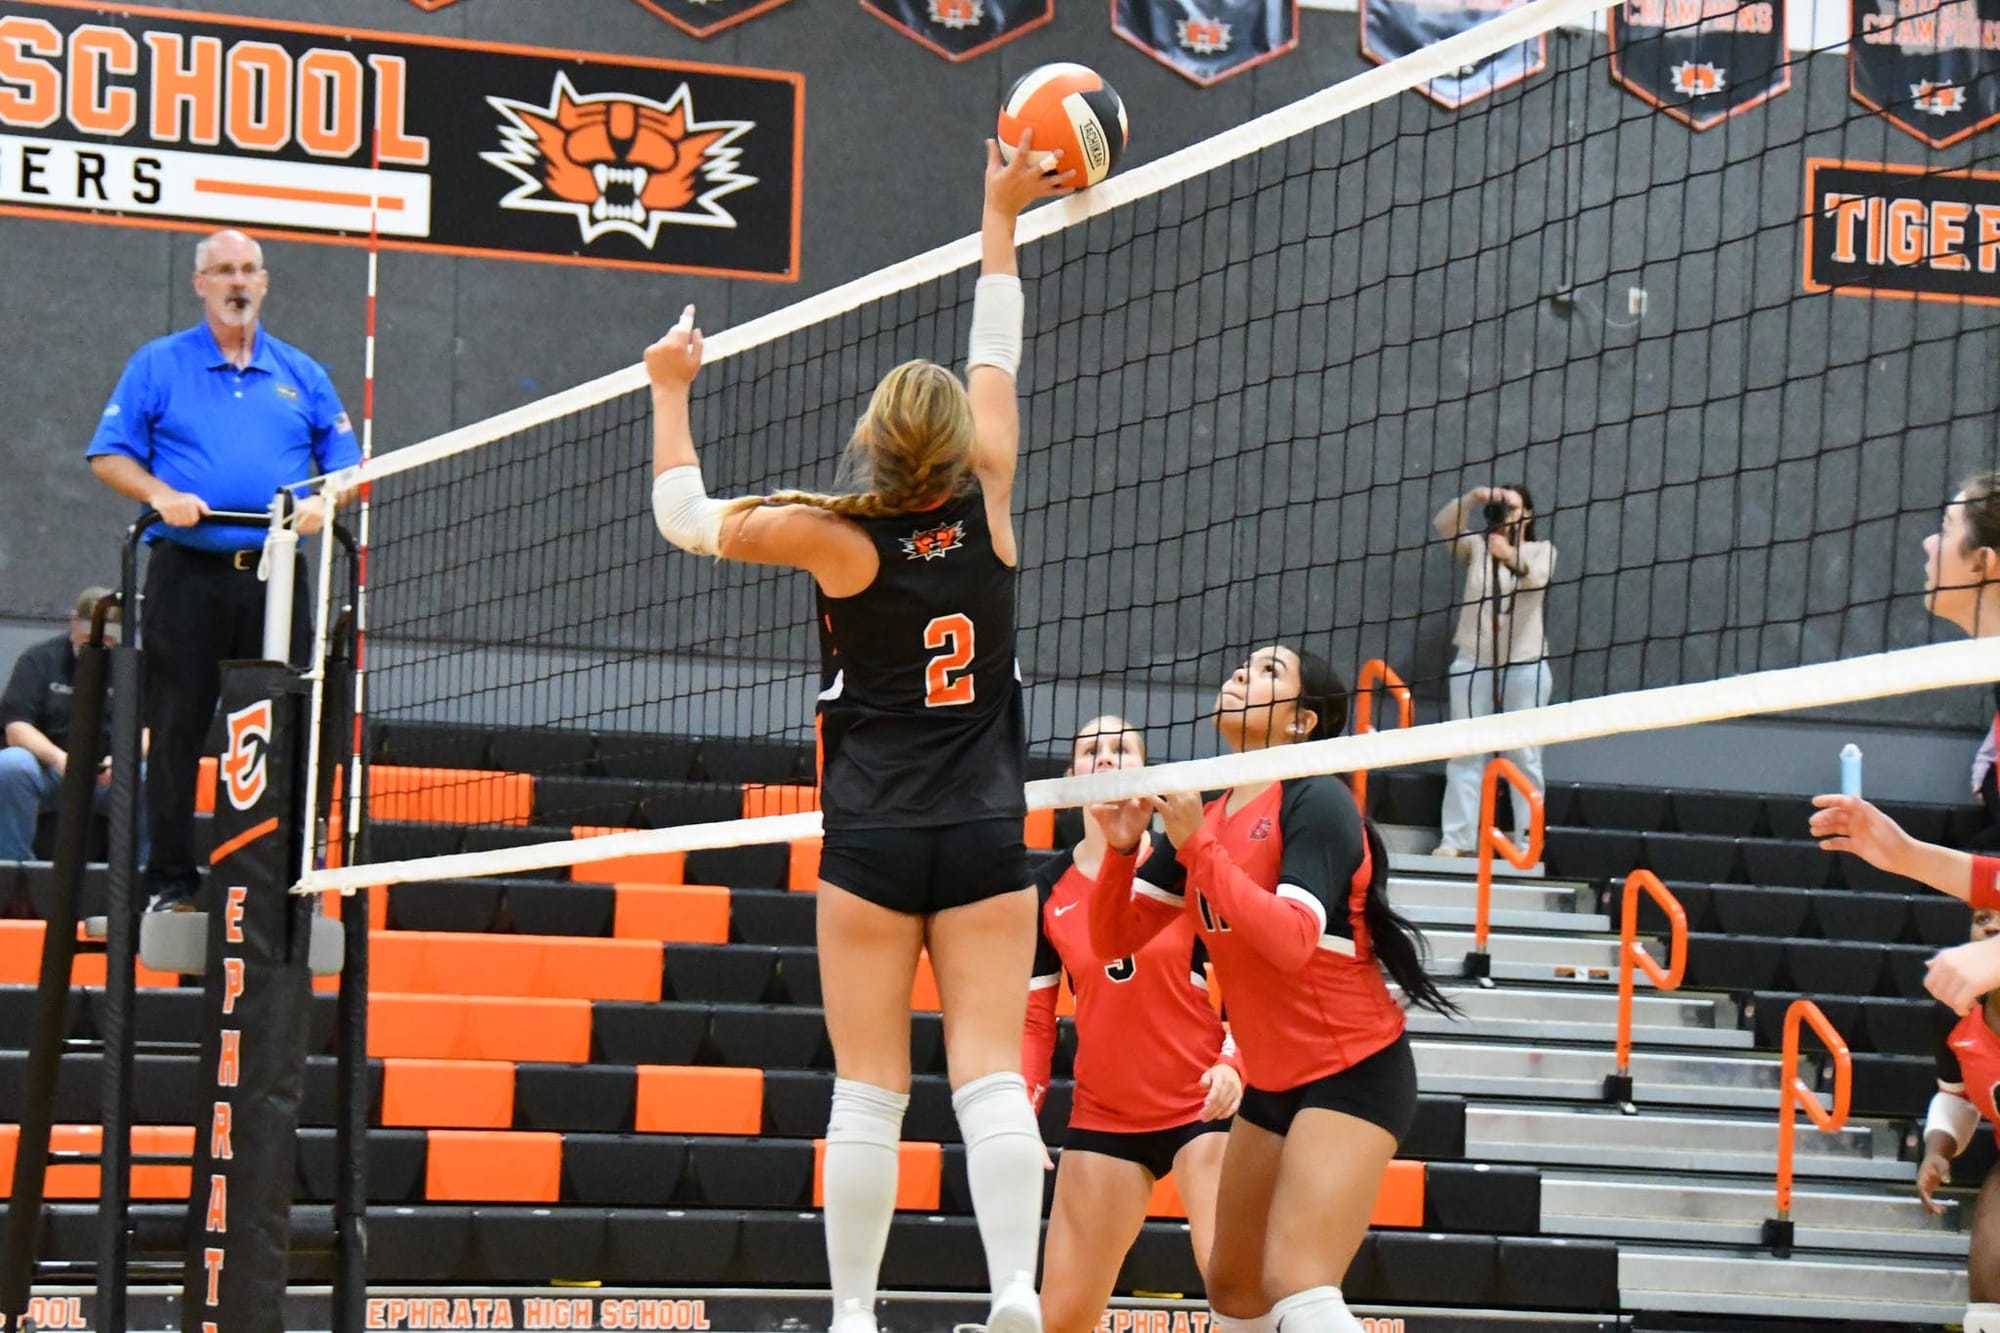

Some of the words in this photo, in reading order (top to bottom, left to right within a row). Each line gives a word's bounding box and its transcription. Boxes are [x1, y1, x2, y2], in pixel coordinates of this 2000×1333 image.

[0, 15, 430, 166] SCHOOL
[924, 613, 975, 707] 2
[202, 886, 248, 1333] EPHRAT
[366, 1298, 514, 1330] EPHRATA
[523, 1298, 593, 1330] HIGH
[601, 1299, 711, 1330] SCHOOL
